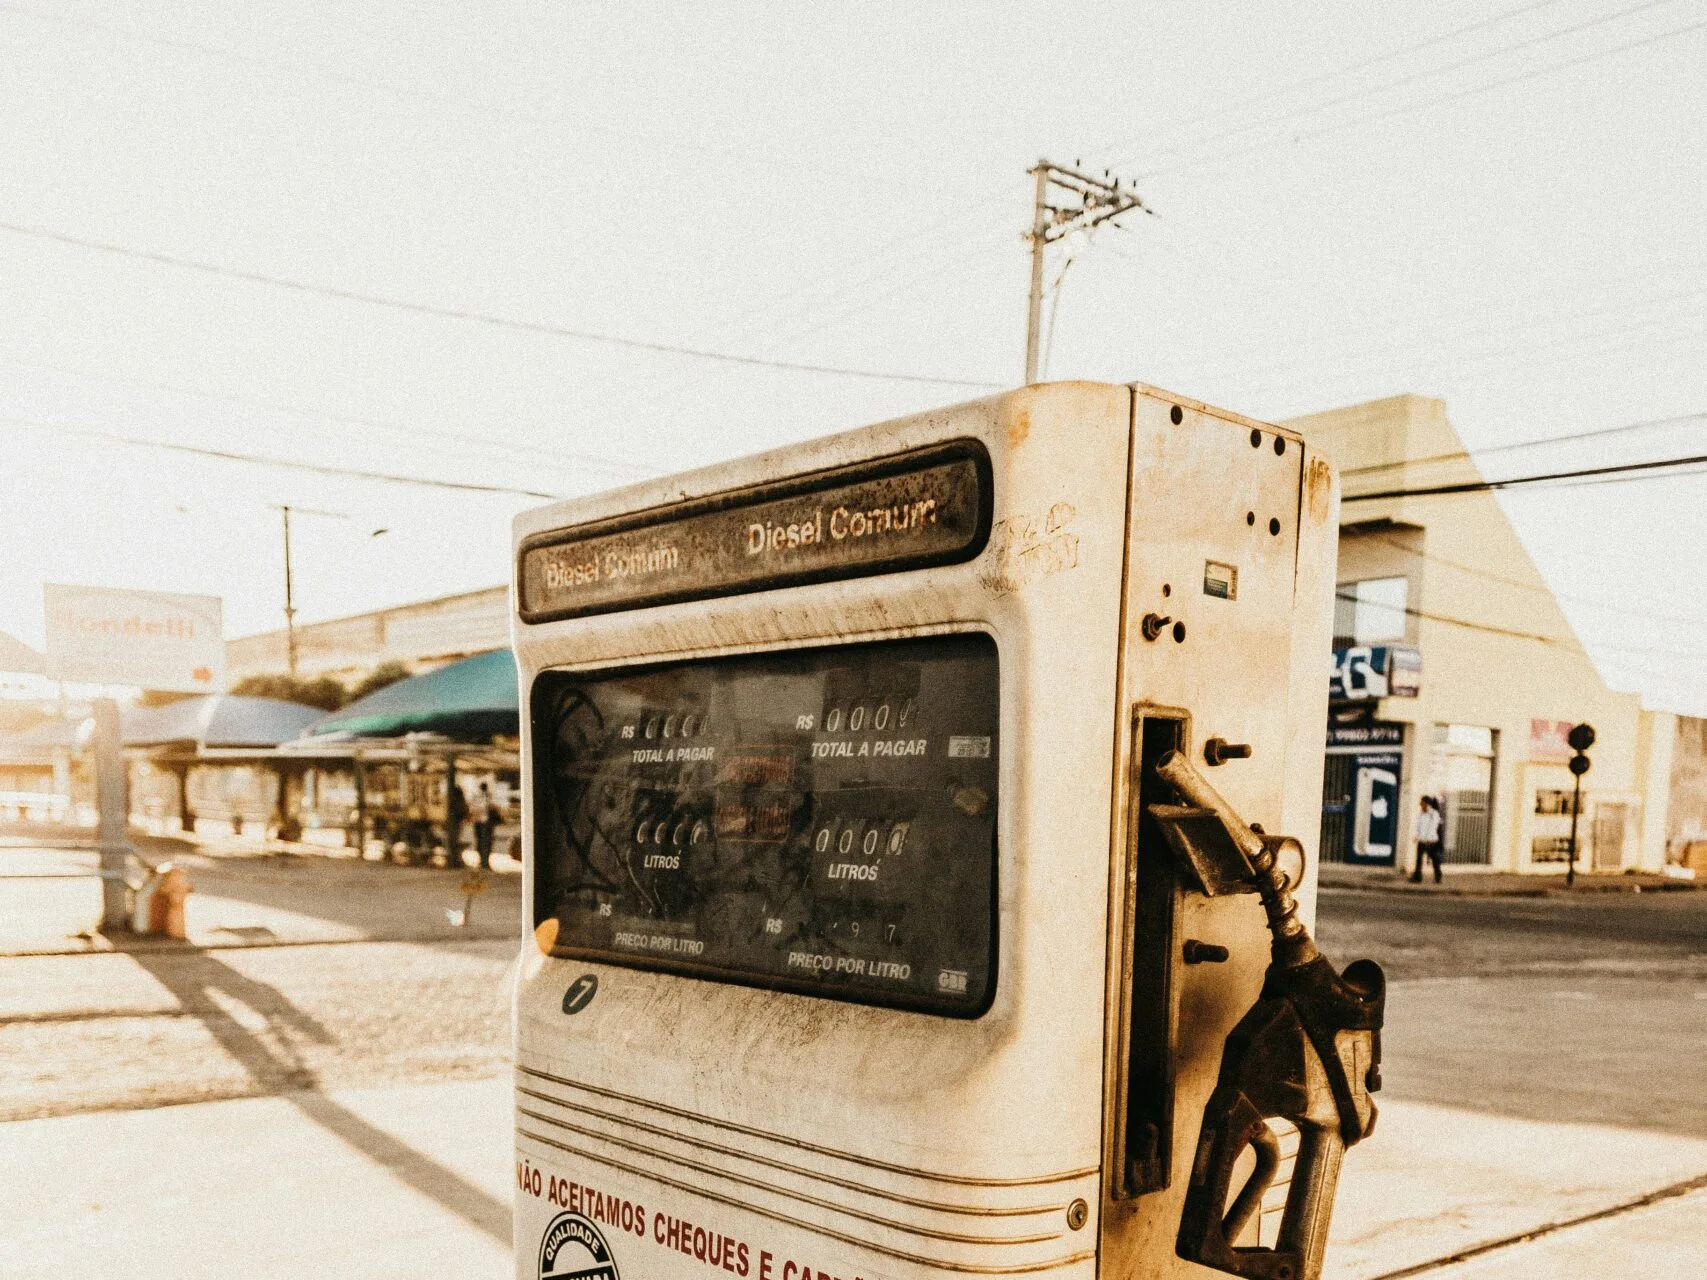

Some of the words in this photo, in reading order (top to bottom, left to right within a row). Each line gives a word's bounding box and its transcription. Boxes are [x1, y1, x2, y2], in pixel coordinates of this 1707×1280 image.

[748, 511, 821, 554] Diesel
[830, 499, 936, 540] Comum
[547, 552, 599, 588] Diesel
[605, 547, 678, 579] Comum
[633, 749, 663, 764] TOTAL
[666, 748, 675, 762] A
[676, 746, 715, 762] PAGAR
[812, 741, 854, 758] TOTAL
[857, 741, 869, 757] A
[873, 739, 927, 757] PAGAR
[644, 854, 680, 869] LITROS
[828, 863, 879, 881] LITROS
[650, 935, 671, 951] POR
[673, 938, 704, 956] LITRO
[835, 957, 865, 976] POR
[869, 960, 911, 980] LITRO
[569, 978, 593, 1008] 7
[548, 1175, 645, 1237] ACEITAMOS
[654, 1211, 749, 1277] CHEQUES
[545, 1222, 600, 1261] QUALIDADE
